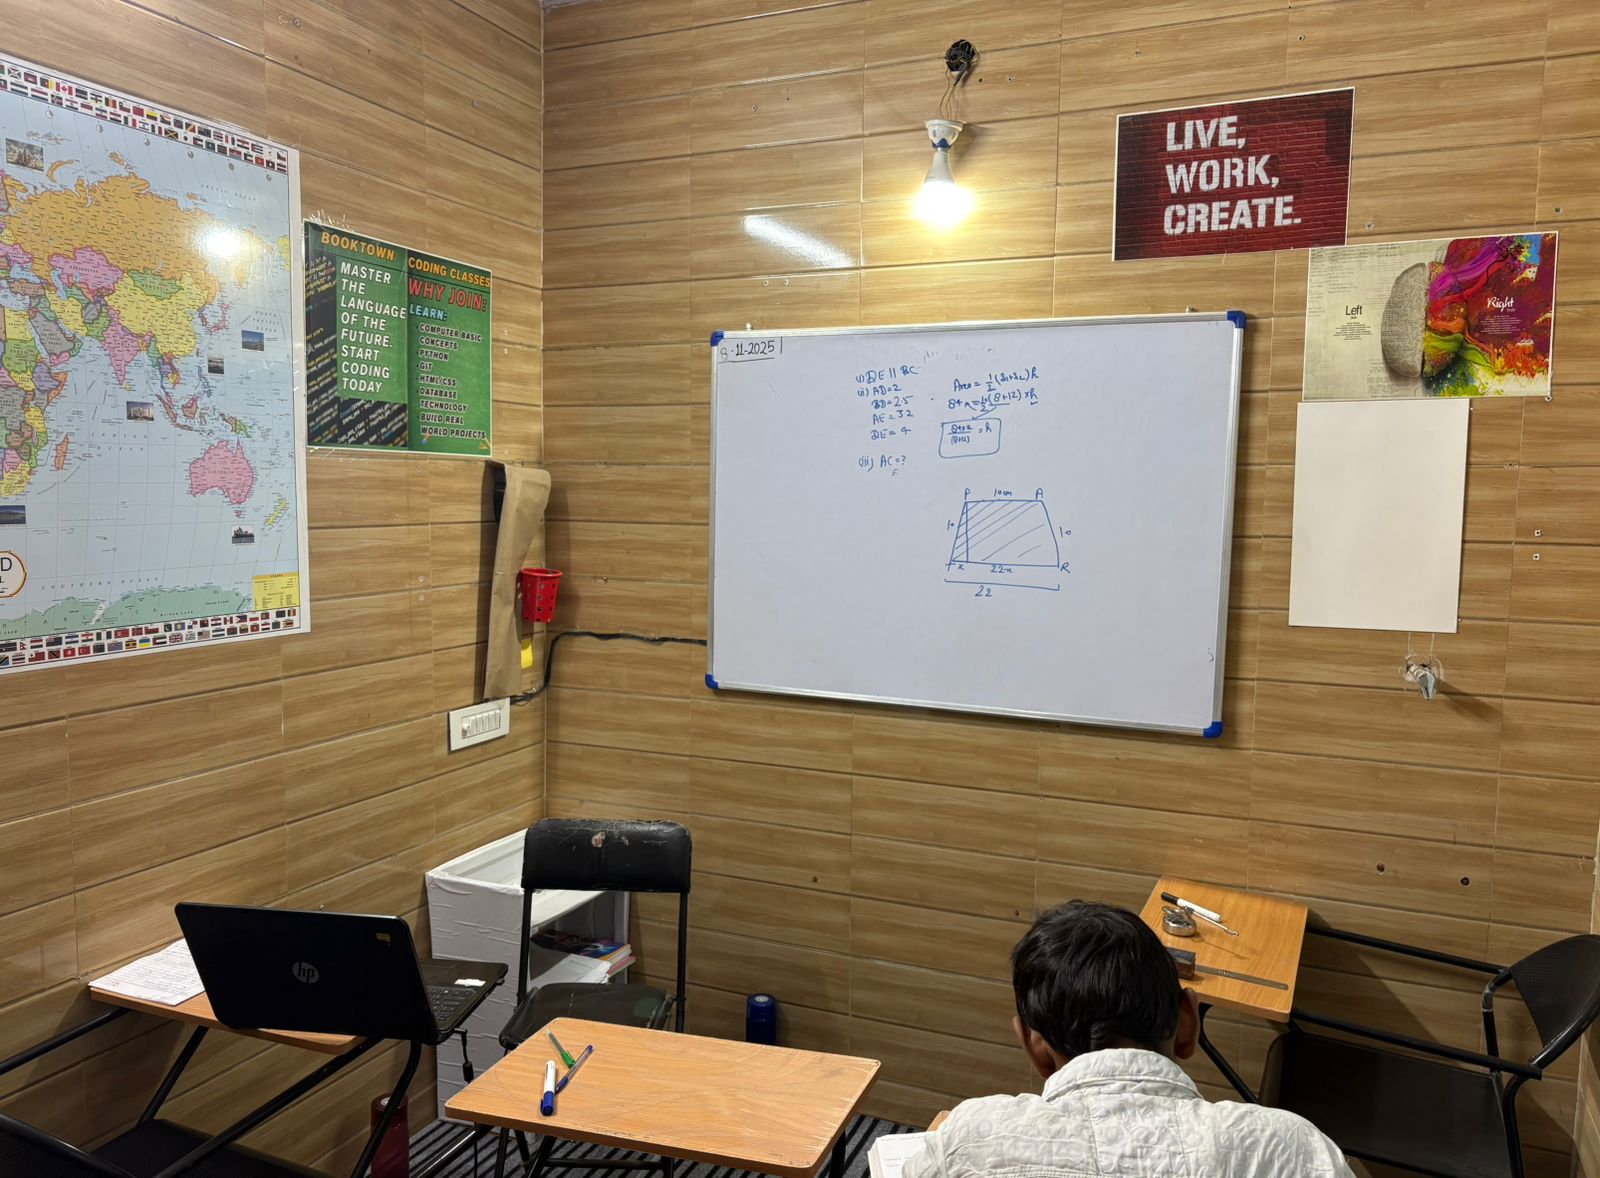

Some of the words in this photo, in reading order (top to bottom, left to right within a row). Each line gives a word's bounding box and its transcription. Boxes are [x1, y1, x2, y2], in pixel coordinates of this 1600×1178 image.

[1166, 115, 1246, 152] LIVE,
[1165, 154, 1280, 194] WORK,
[1163, 195, 1302, 236] CREATE.
[320, 231, 396, 261] BOOKTOWN
[340, 261, 392, 285] MASTER
[408, 256, 447, 277] CODING
[449, 268, 491, 289] CLASSES
[341, 278, 366, 295] THE
[408, 277, 445, 302] WHY
[448, 288, 487, 313] JOIN:
[340, 295, 407, 319] LANGUAGE
[409, 303, 448, 321] LEARN:
[1345, 304, 1363, 316] Left
[1487, 296, 1515, 312] Right
[341, 312, 358, 325] OF
[363, 316, 387, 331] THE
[341, 328, 393, 348] FUTURE.
[419, 323, 458, 338] COMPUTER
[461, 330, 482, 342] BASIC
[419, 336, 458, 350] CONCEPTS
[341, 345, 380, 362] START
[419, 349, 449, 361] PYTHON
[341, 361, 391, 379] CODING
[419, 362, 433, 371] GIT
[341, 377, 383, 394] TODAY
[419, 374, 457, 387] HTML/CSS
[419, 387, 457, 399] DATABASE
[420, 400, 468, 412] TECHNOLOGY
[420, 413, 443, 423] BUILD
[445, 415, 464, 425] REAL
[421, 426, 448, 437] WORLD
[450, 427, 486, 439] PROJECTS
[974, 585, 992, 597] 22
